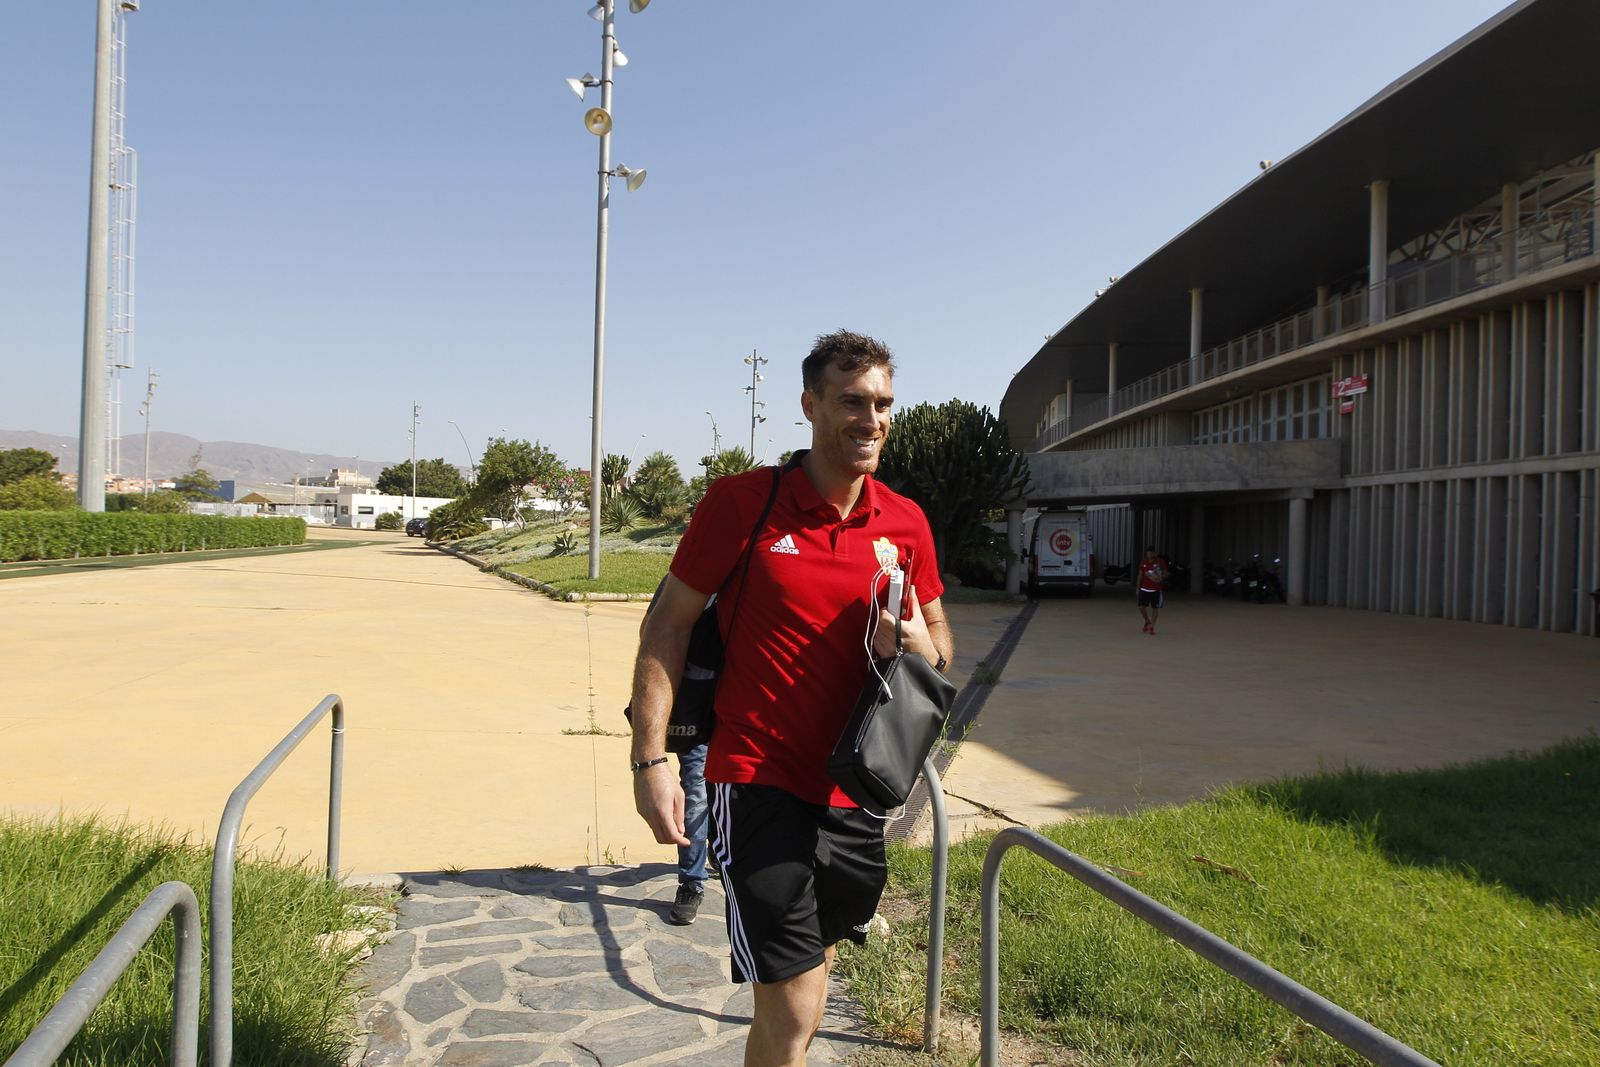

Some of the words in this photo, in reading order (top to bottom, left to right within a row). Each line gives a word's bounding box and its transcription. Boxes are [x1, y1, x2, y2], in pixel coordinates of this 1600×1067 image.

[1338, 381, 1346, 396] 2
[770, 546, 799, 555] adidas
[668, 724, 697, 736] ma
